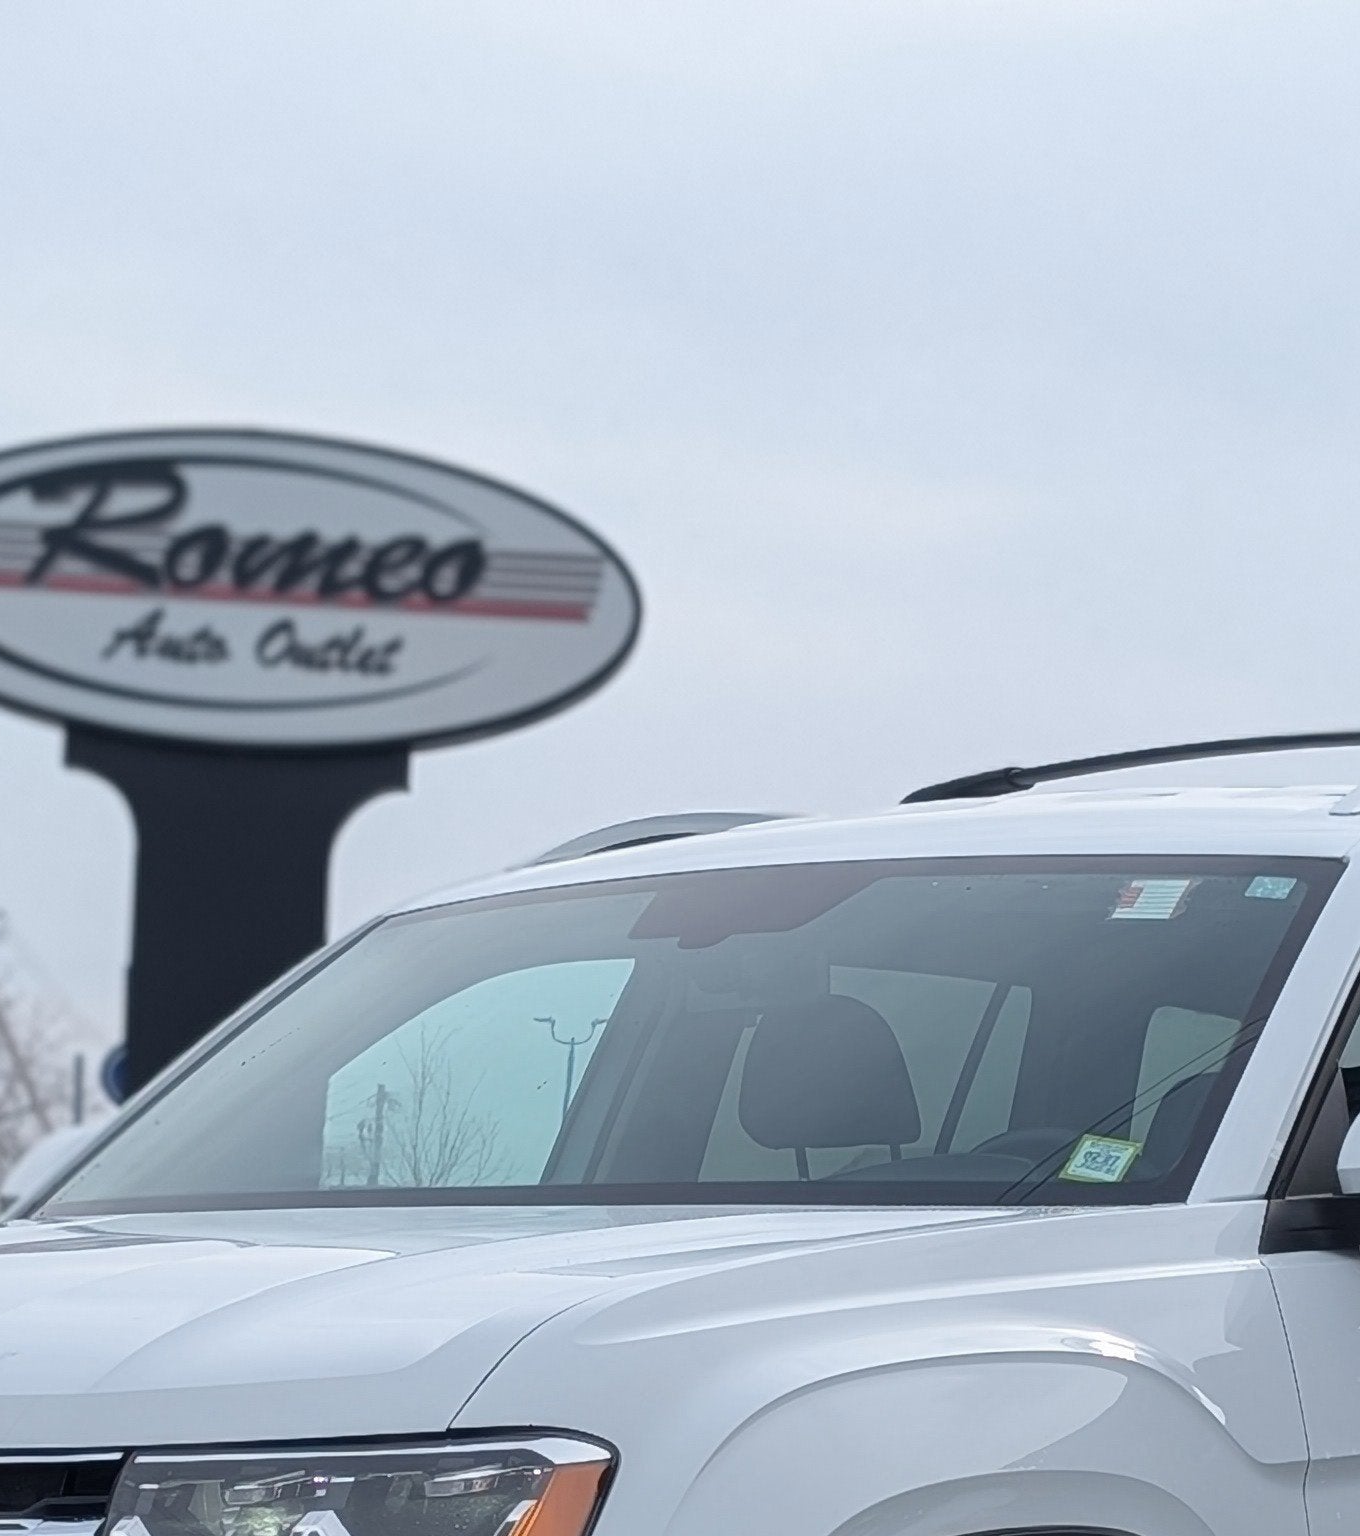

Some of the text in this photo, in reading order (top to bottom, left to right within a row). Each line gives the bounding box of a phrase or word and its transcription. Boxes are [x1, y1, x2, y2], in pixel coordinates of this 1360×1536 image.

[26, 460, 486, 605] Romeo
[101, 609, 405, 677] Auto Outlet
